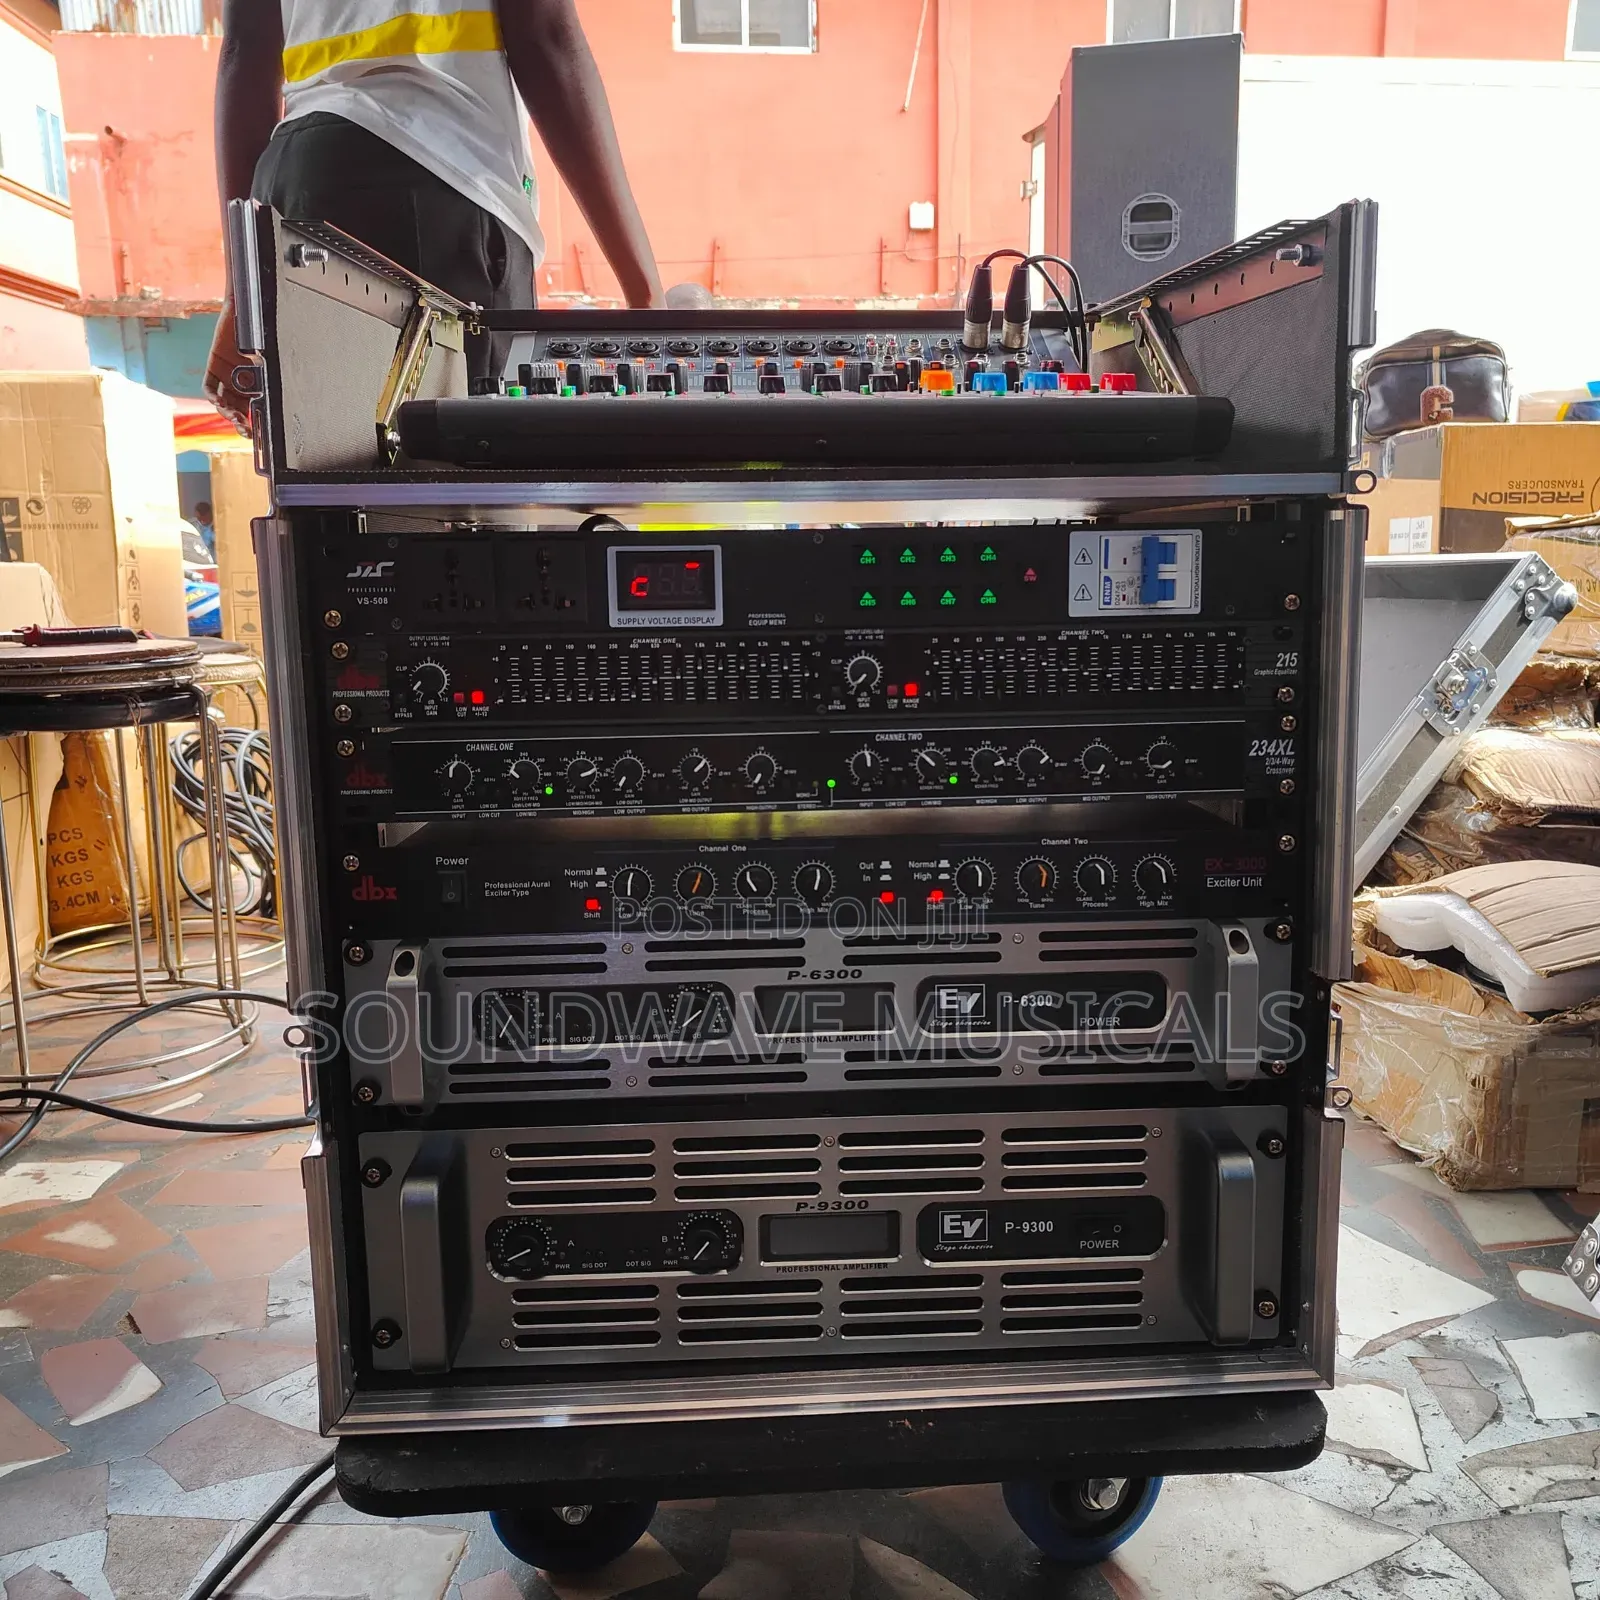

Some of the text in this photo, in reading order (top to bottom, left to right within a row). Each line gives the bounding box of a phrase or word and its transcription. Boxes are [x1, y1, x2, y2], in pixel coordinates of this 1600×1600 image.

[1508, 480, 1584, 489] TRANSDUCERS
[617, 616, 715, 626] SUPPLY VOLTAGE DISPLAY
[1276, 652, 1298, 668] 215
[1253, 668, 1298, 676] Graphic Equalizer
[333, 689, 390, 698] PROFESSIONAL PRODUCTS
[875, 733, 923, 742] CHANNEL TWO
[466, 743, 514, 752] CHANNEL ONE
[1248, 739, 1295, 757] 234XL
[1265, 757, 1295, 767] 2/3/4-Way
[1041, 838, 1089, 846] Channel Two
[699, 844, 747, 853] Channel One
[51, 849, 89, 867] KGS
[435, 856, 469, 866] Power
[859, 862, 874, 870] Out
[908, 861, 937, 869] Normal
[564, 868, 593, 877] Normal
[913, 872, 932, 881] High
[57, 870, 95, 889] KGS
[862, 874, 871, 882] In
[1206, 876, 1263, 888] Exciter Unit
[351, 875, 397, 901] dbx
[484, 880, 551, 889] Professional Aural
[570, 880, 589, 889] High
[485, 888, 530, 898] Exciter Type
[1139, 900, 1155, 908] High
[618, 911, 633, 919] Low
[742, 908, 769, 916] Process
[787, 969, 863, 981] P-6300
[1002, 995, 1053, 1008] P-6300
[1079, 1016, 1120, 1027] POWER
[768, 1034, 882, 1045] PROFESSIONAL AMPLIFIER
[795, 1200, 870, 1212] P-9300
[1004, 1220, 1054, 1234] P-9300
[567, 1239, 575, 1247] A
[1080, 1239, 1120, 1250] POWER
[776, 1262, 888, 1273] PROFESSIONAL AMPLIFIER
